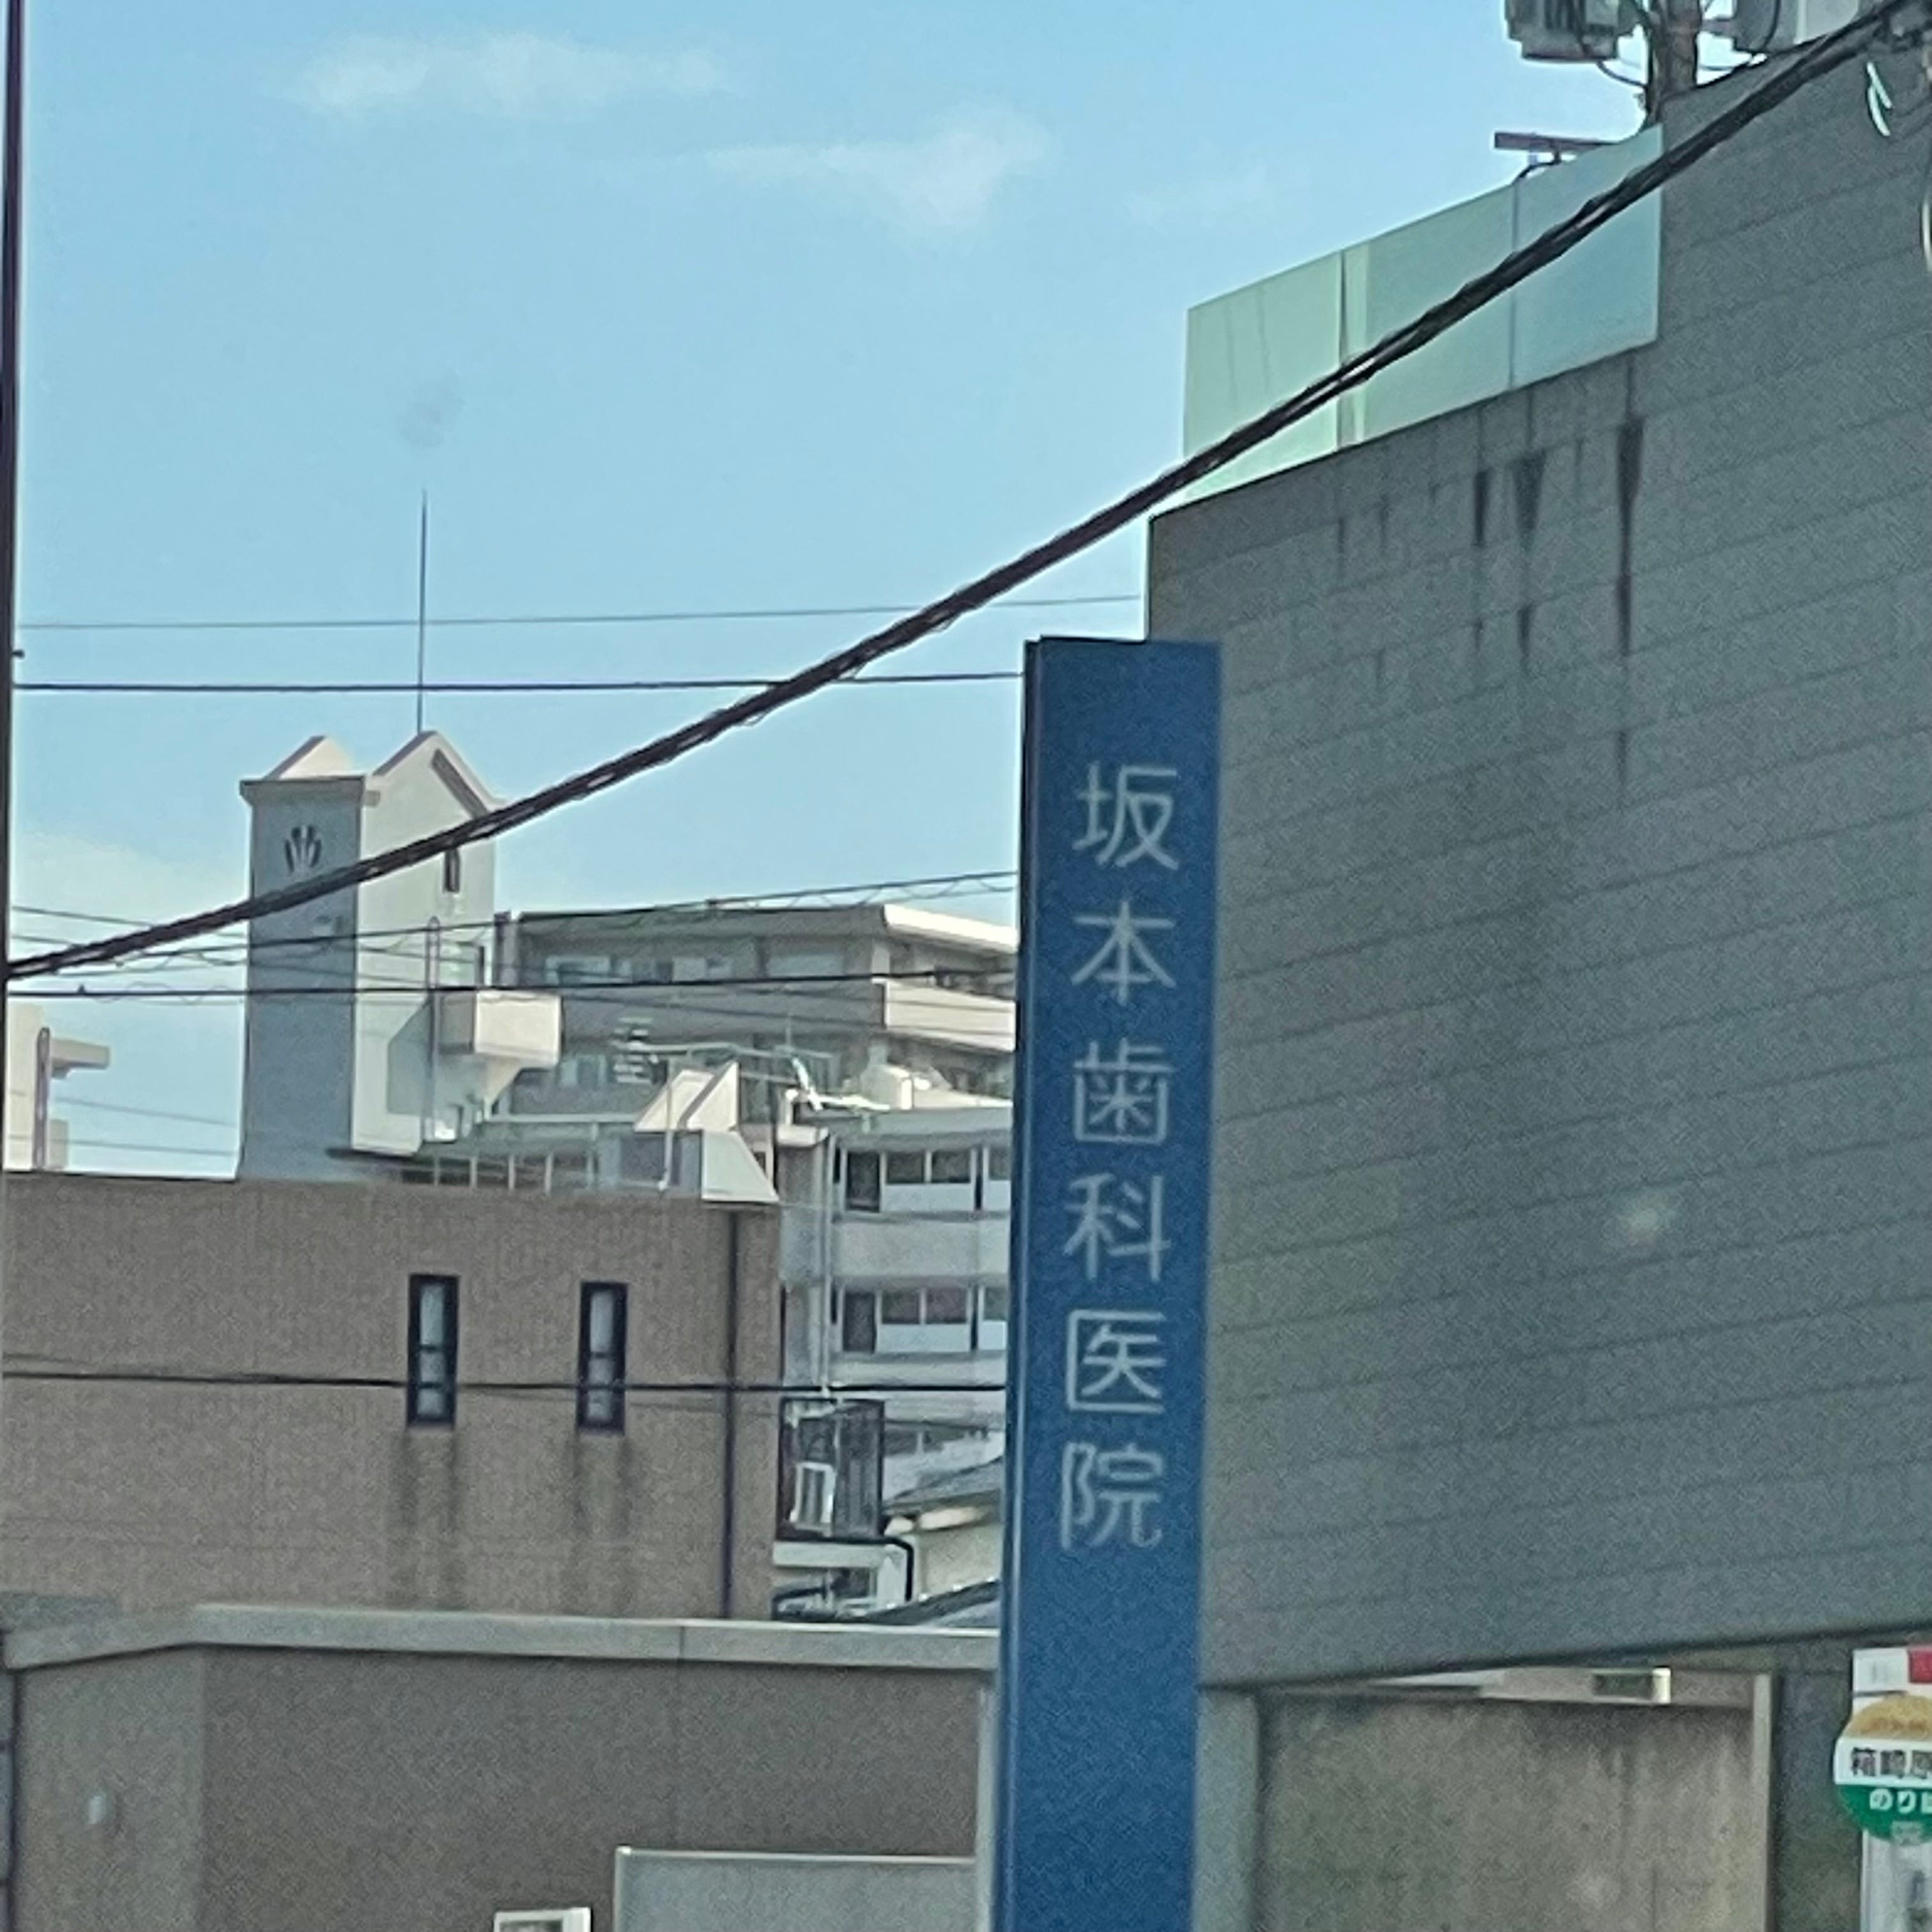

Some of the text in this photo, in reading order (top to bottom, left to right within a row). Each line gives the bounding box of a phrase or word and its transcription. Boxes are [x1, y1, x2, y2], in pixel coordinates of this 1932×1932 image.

[1060, 761, 1181, 1551] 坂本歯科医院
